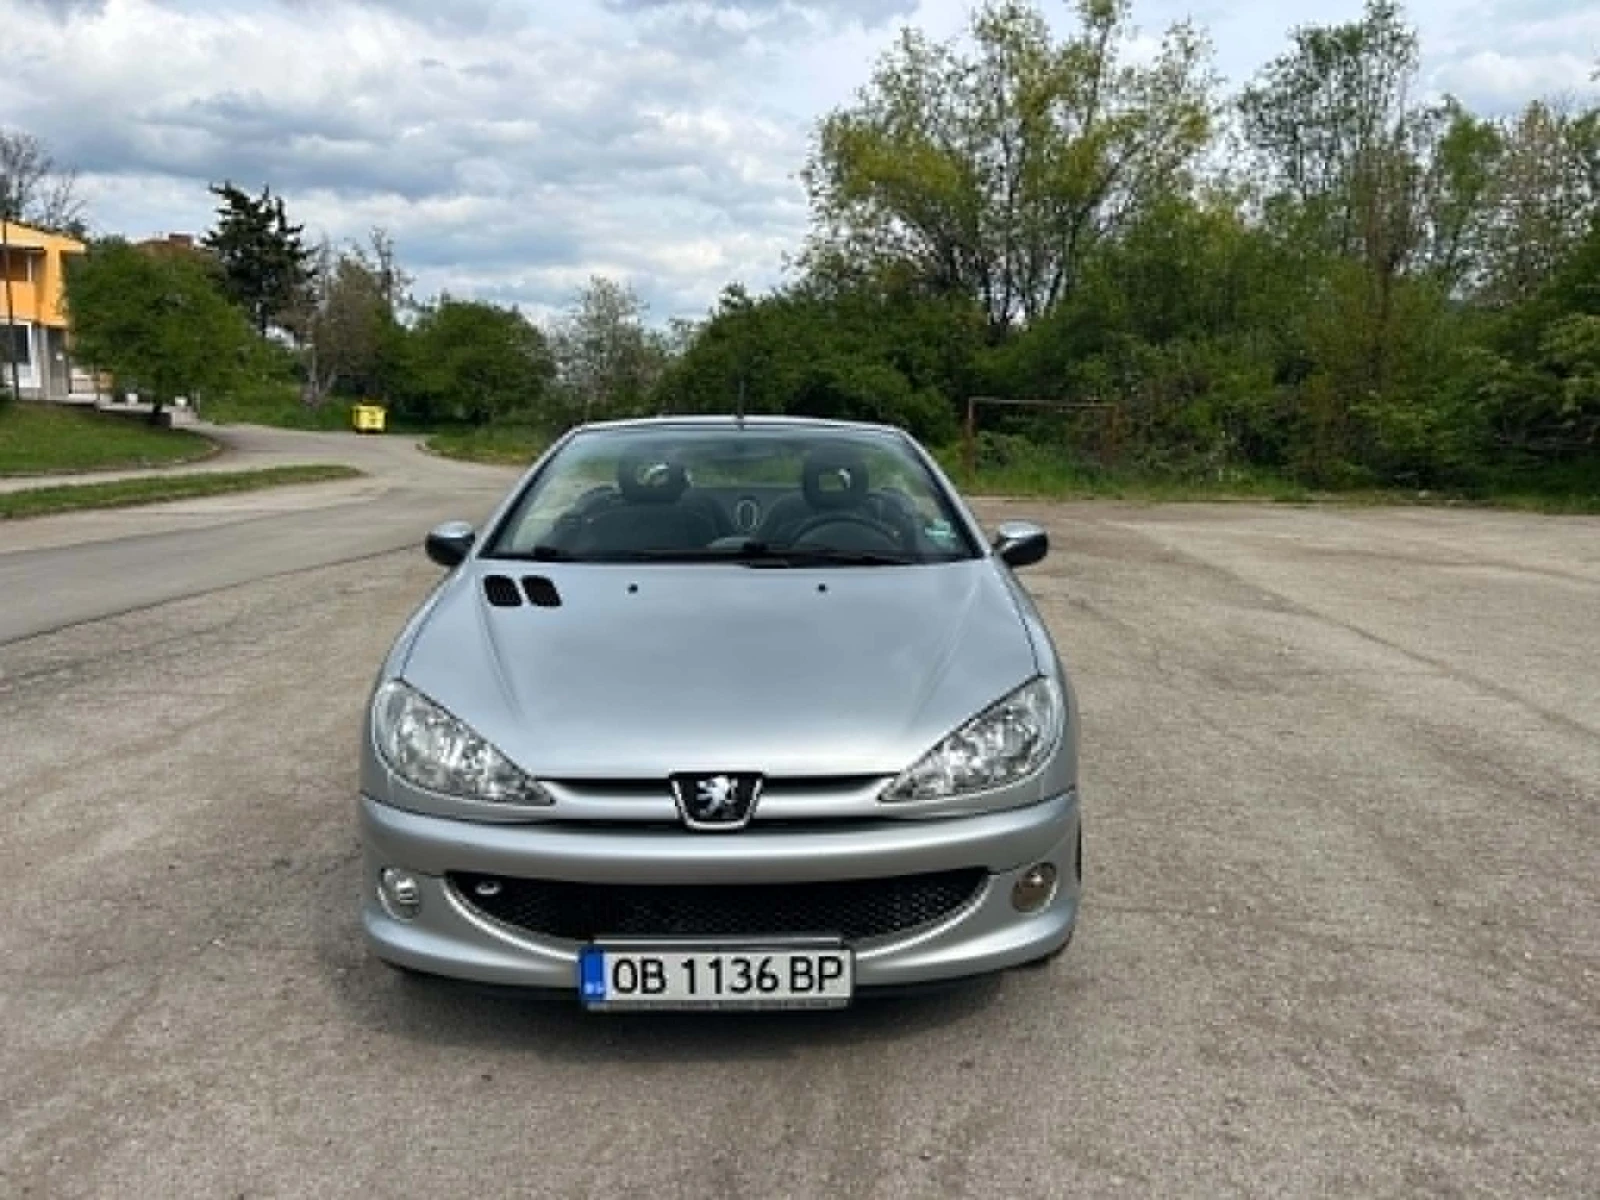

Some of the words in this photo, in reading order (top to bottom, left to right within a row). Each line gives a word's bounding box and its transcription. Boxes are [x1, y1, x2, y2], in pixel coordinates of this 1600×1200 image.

[612, 958, 667, 995] OB
[681, 957, 779, 995] 1136
[789, 955, 844, 993] BP
